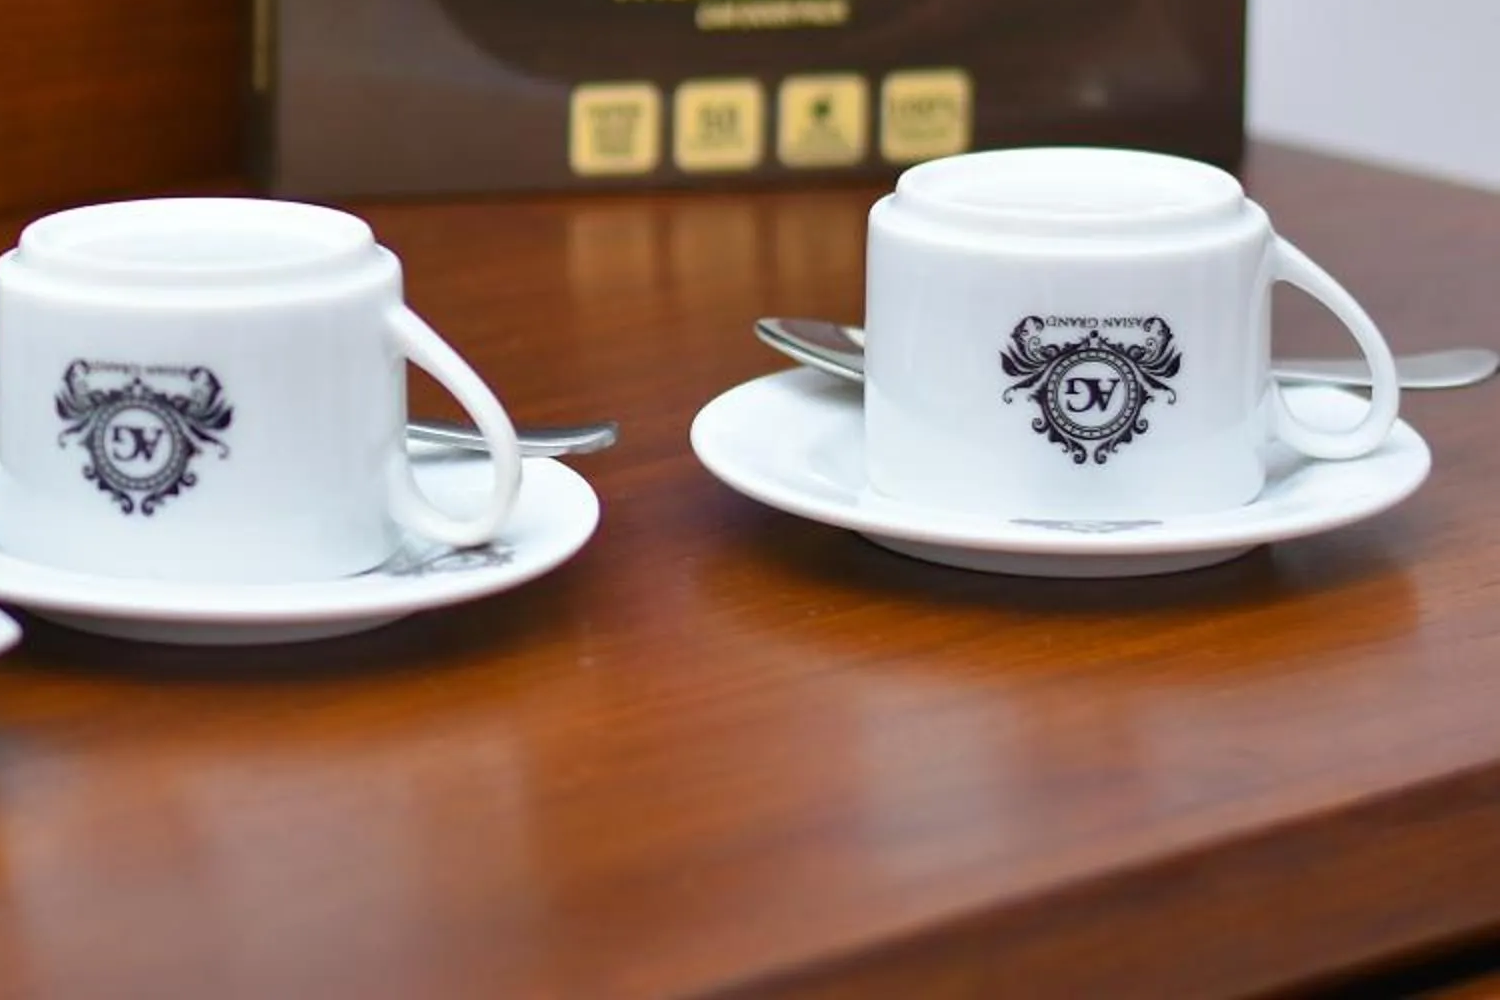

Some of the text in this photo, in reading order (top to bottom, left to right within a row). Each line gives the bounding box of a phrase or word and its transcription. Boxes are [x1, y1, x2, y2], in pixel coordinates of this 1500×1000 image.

[1045, 316, 1143, 329] ASIAN GRAND
[1064, 377, 1120, 412] AG
